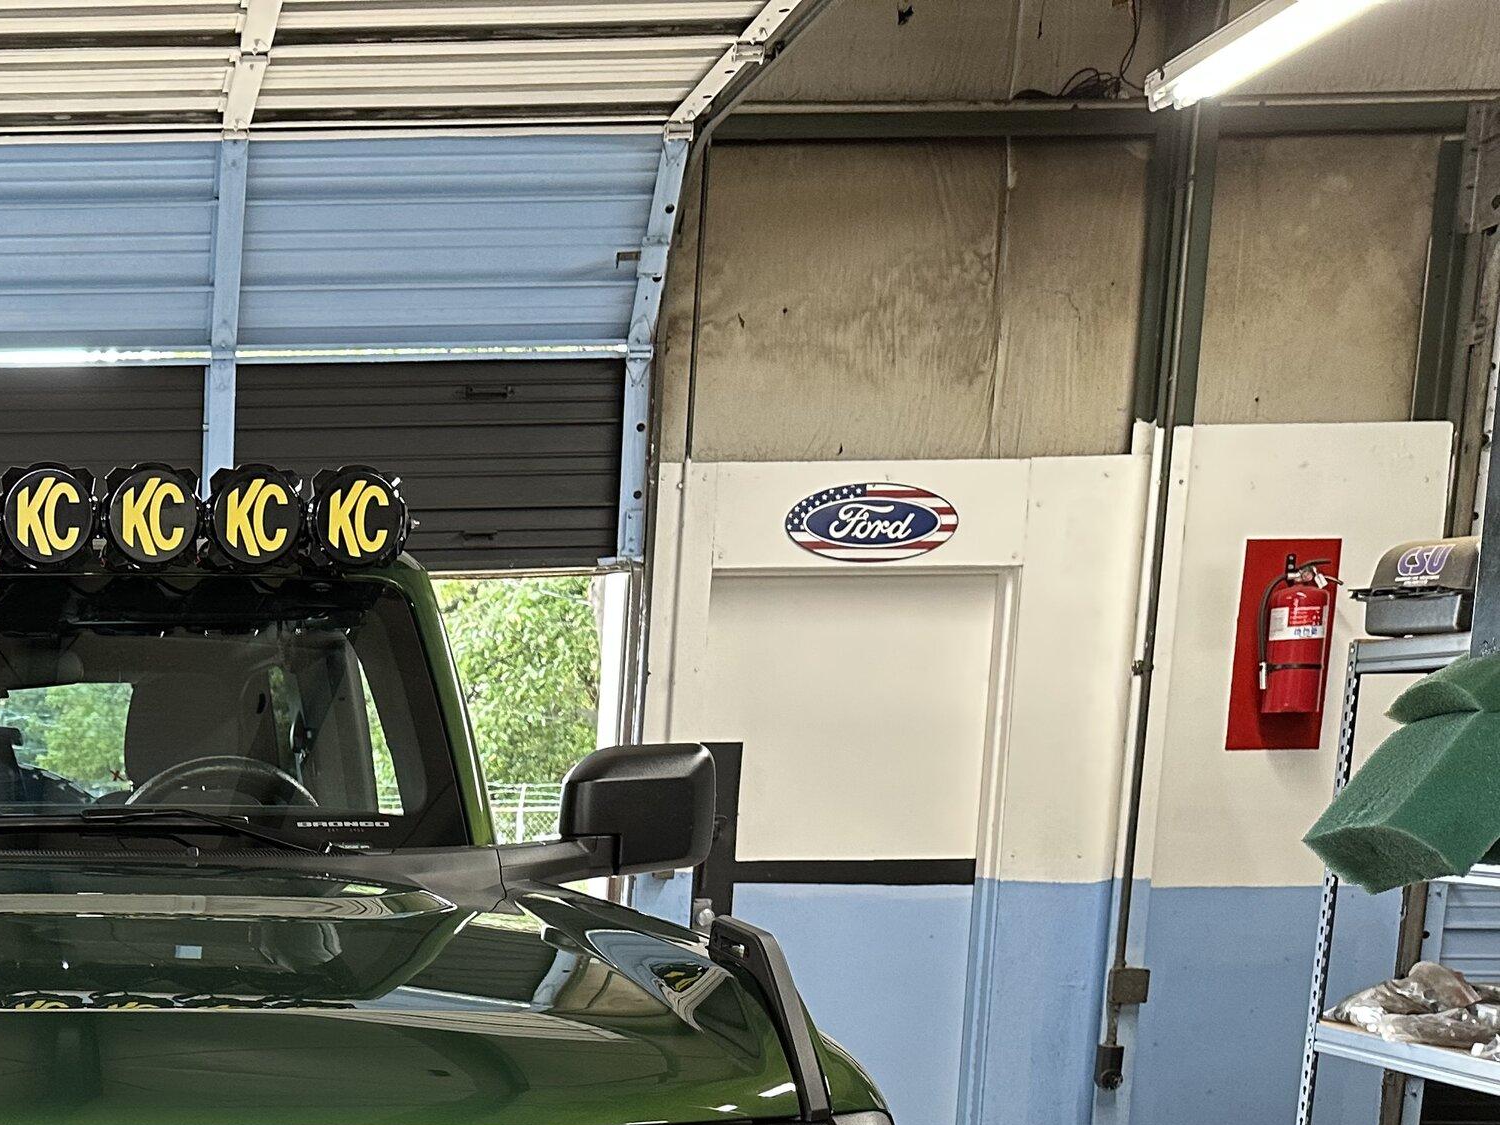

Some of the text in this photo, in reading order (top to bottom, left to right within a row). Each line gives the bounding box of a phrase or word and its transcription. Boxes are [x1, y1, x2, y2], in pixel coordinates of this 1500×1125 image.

[16, 477, 80, 556] KC
[122, 478, 185, 556] KC
[226, 479, 288, 557] KC
[328, 480, 389, 558] KC
[828, 503, 916, 539] Ford
[1397, 544, 1456, 576] CSU
